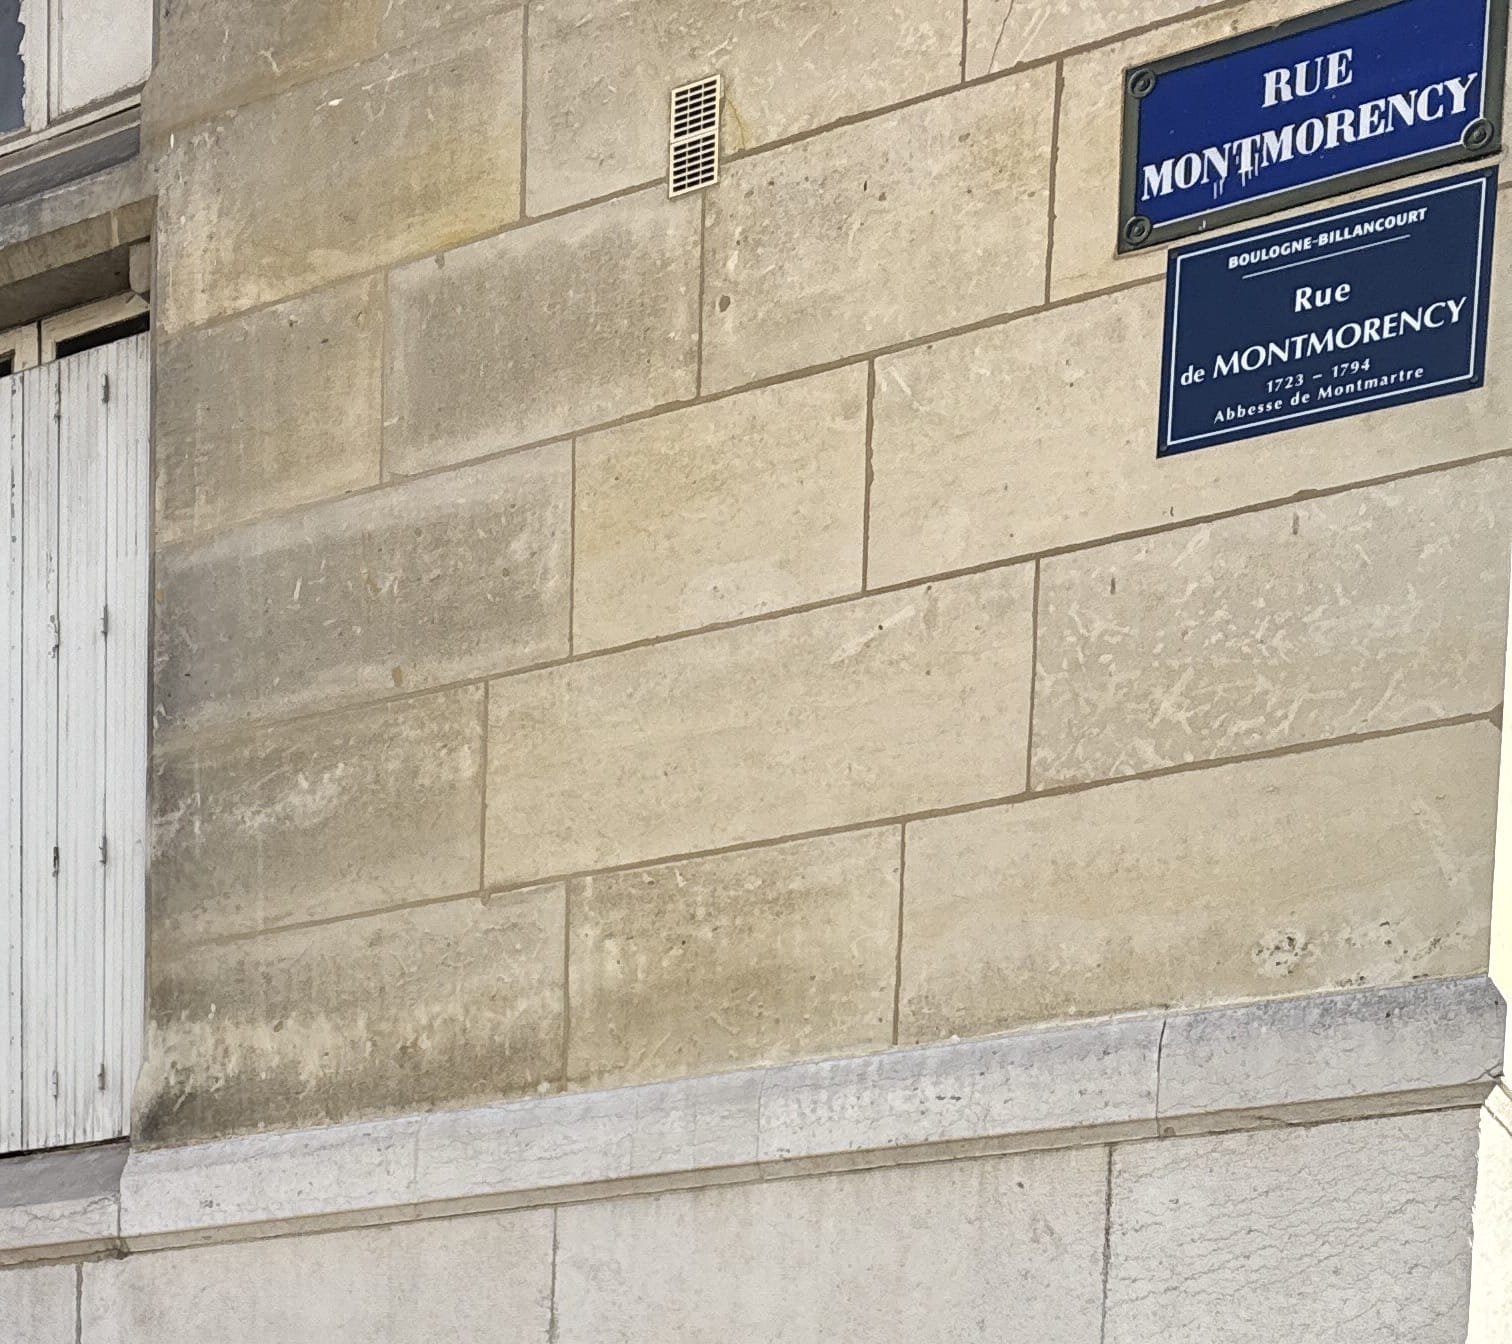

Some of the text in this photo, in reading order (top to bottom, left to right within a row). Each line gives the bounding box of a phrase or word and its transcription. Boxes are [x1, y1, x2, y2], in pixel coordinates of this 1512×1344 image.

[1261, 48, 1354, 108] RUE
[1140, 73, 1479, 201] MONTMORENCY
[1228, 207, 1428, 270] BOULOGNE-BILLANCOURT
[1294, 282, 1352, 313] Rue
[1180, 297, 1468, 387] de MONTMORENCY
[1214, 365, 1425, 424] Abbesse de Montmartre
[1266, 372, 1305, 394] 1723
[1331, 358, 1371, 378] 1794
